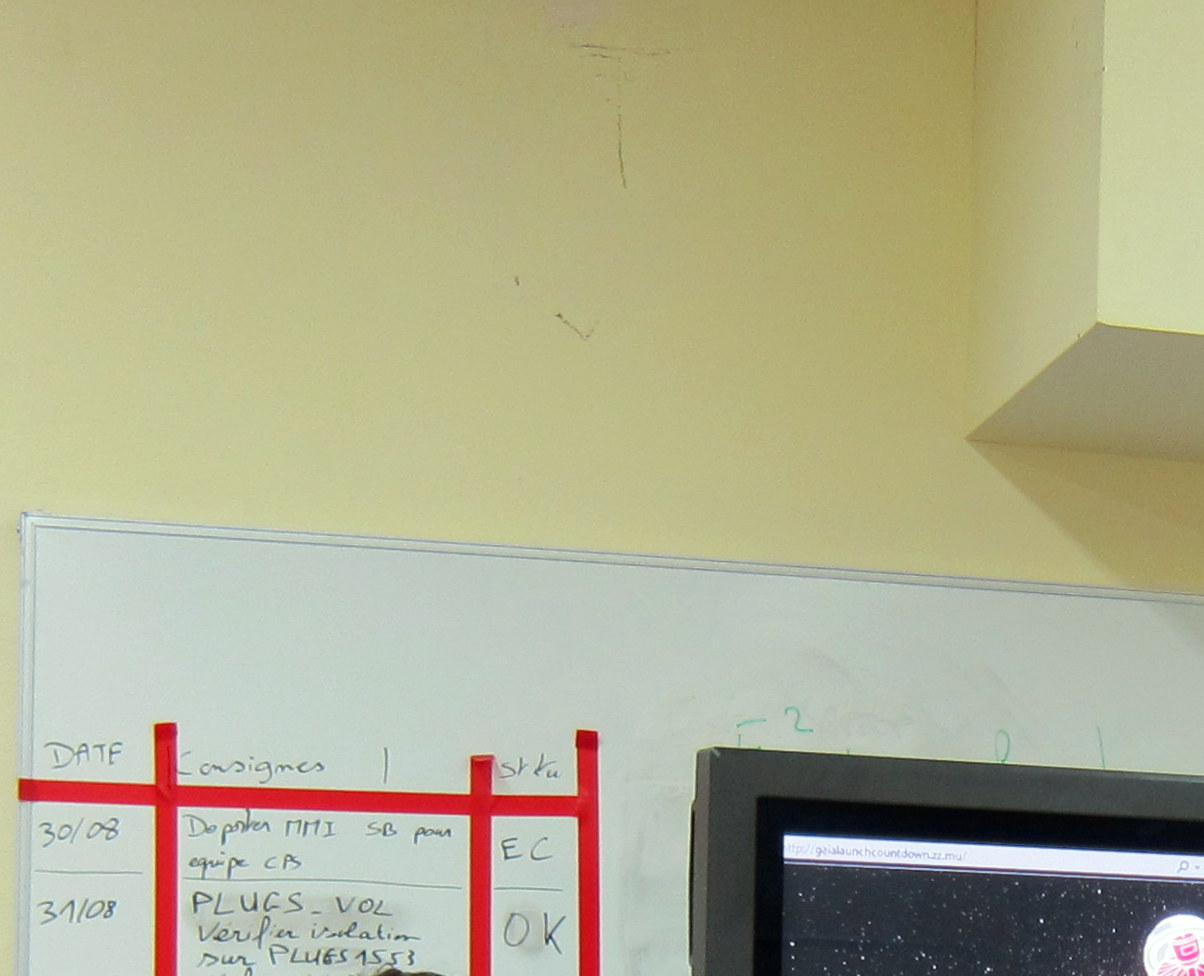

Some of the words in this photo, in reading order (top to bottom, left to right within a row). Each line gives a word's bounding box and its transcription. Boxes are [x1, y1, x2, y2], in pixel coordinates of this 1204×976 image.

[43, 741, 124, 769] DATE
[38, 817, 121, 848] 30/08
[37, 898, 117, 925] 31/08
[504, 912, 567, 955] OK
